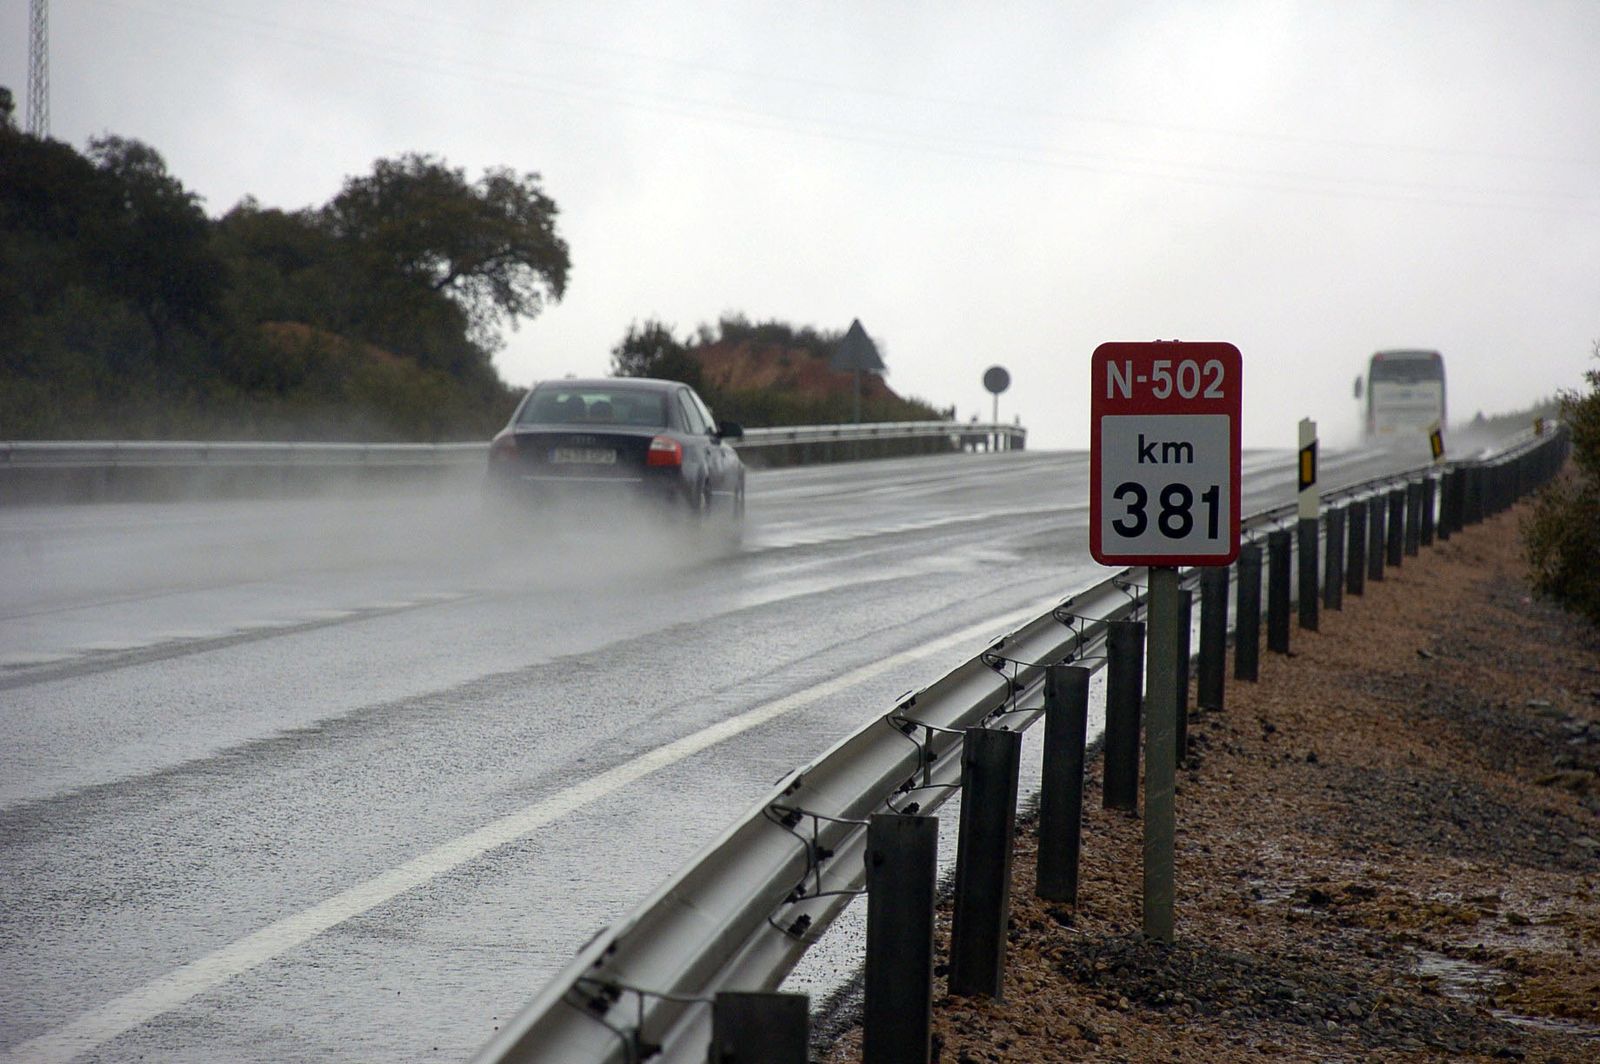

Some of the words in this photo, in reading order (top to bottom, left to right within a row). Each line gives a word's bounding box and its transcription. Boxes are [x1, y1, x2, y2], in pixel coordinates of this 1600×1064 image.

[1106, 359, 1225, 399] N-502
[1137, 434, 1194, 464] km
[1111, 482, 1220, 540] 381
